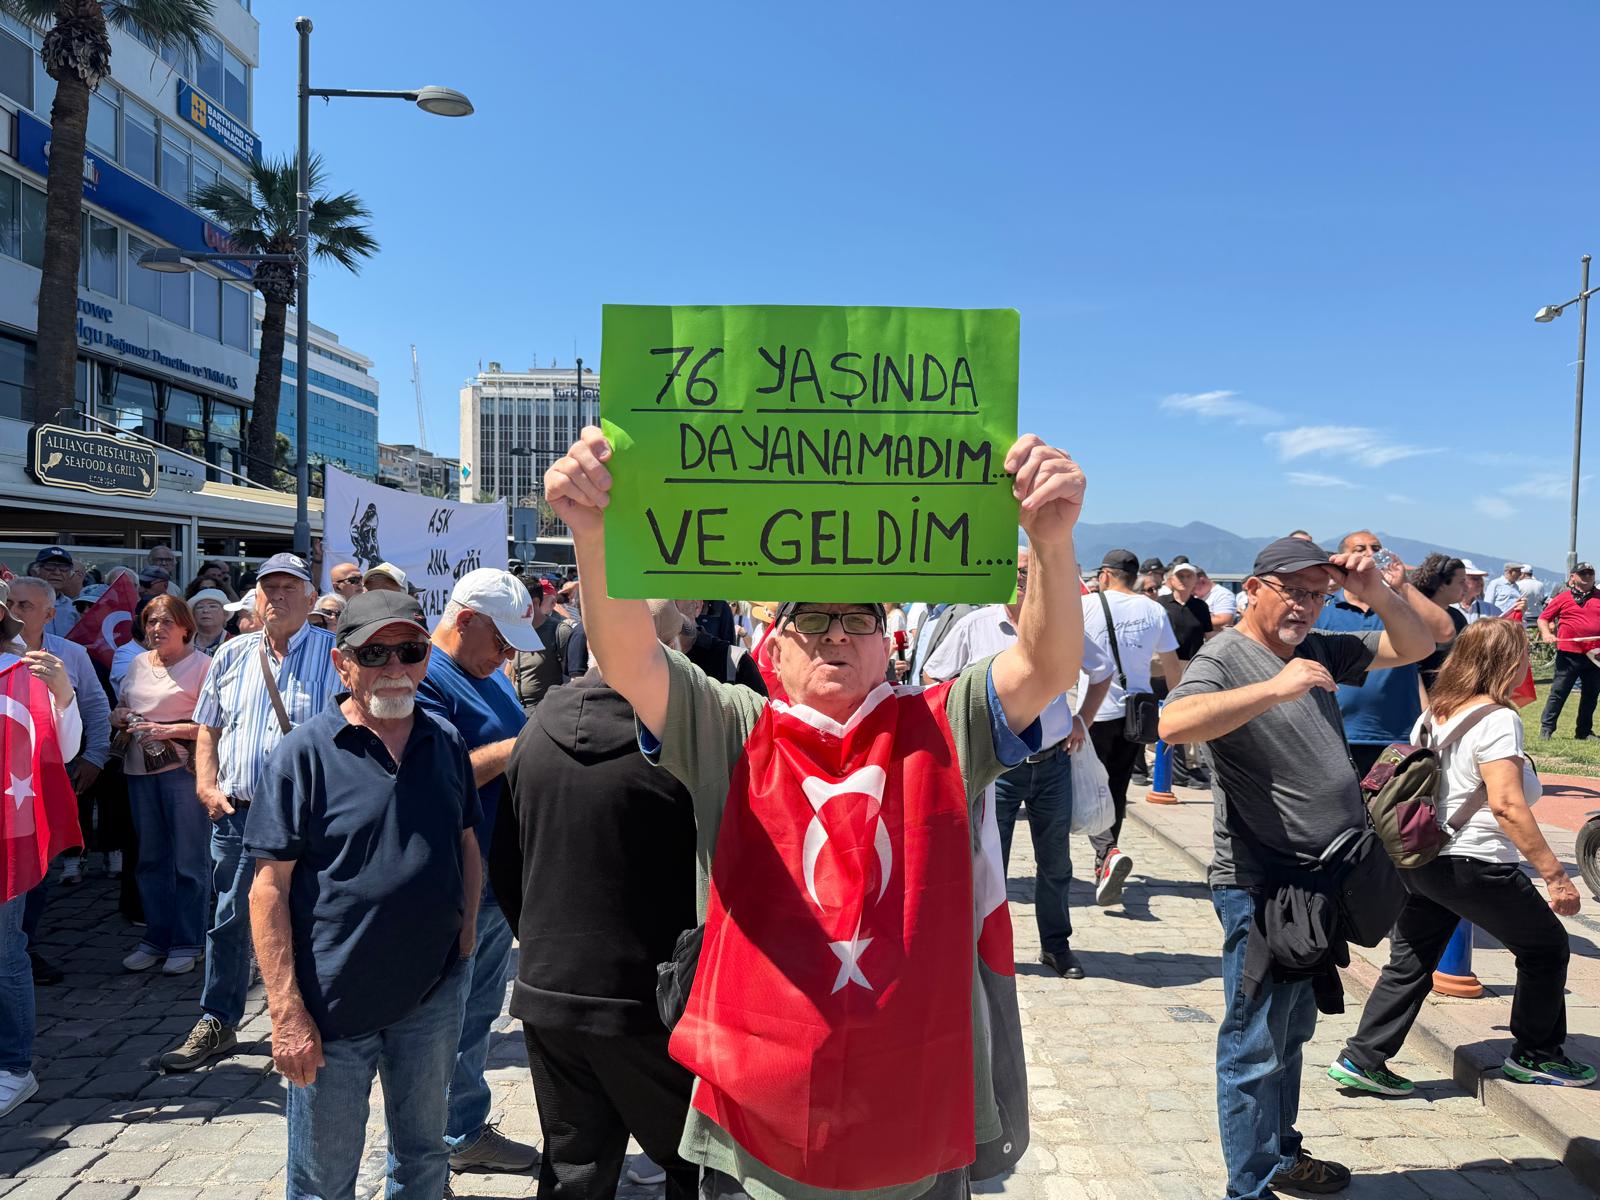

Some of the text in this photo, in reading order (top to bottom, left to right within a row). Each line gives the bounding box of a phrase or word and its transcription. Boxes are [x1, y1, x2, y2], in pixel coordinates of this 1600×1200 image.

[207, 104, 231, 130] BARTH
[231, 122, 245, 140] UND
[77, 298, 113, 323] rowe
[77, 317, 103, 347] lgu
[649, 344, 979, 408] 76 YAŞINDA
[45, 435, 152, 466] ALLIANCE RESTAURANT
[64, 454, 137, 478] SEAFOOD & GRILL
[427, 508, 456, 537] AŞK
[426, 548, 451, 576] ANA
